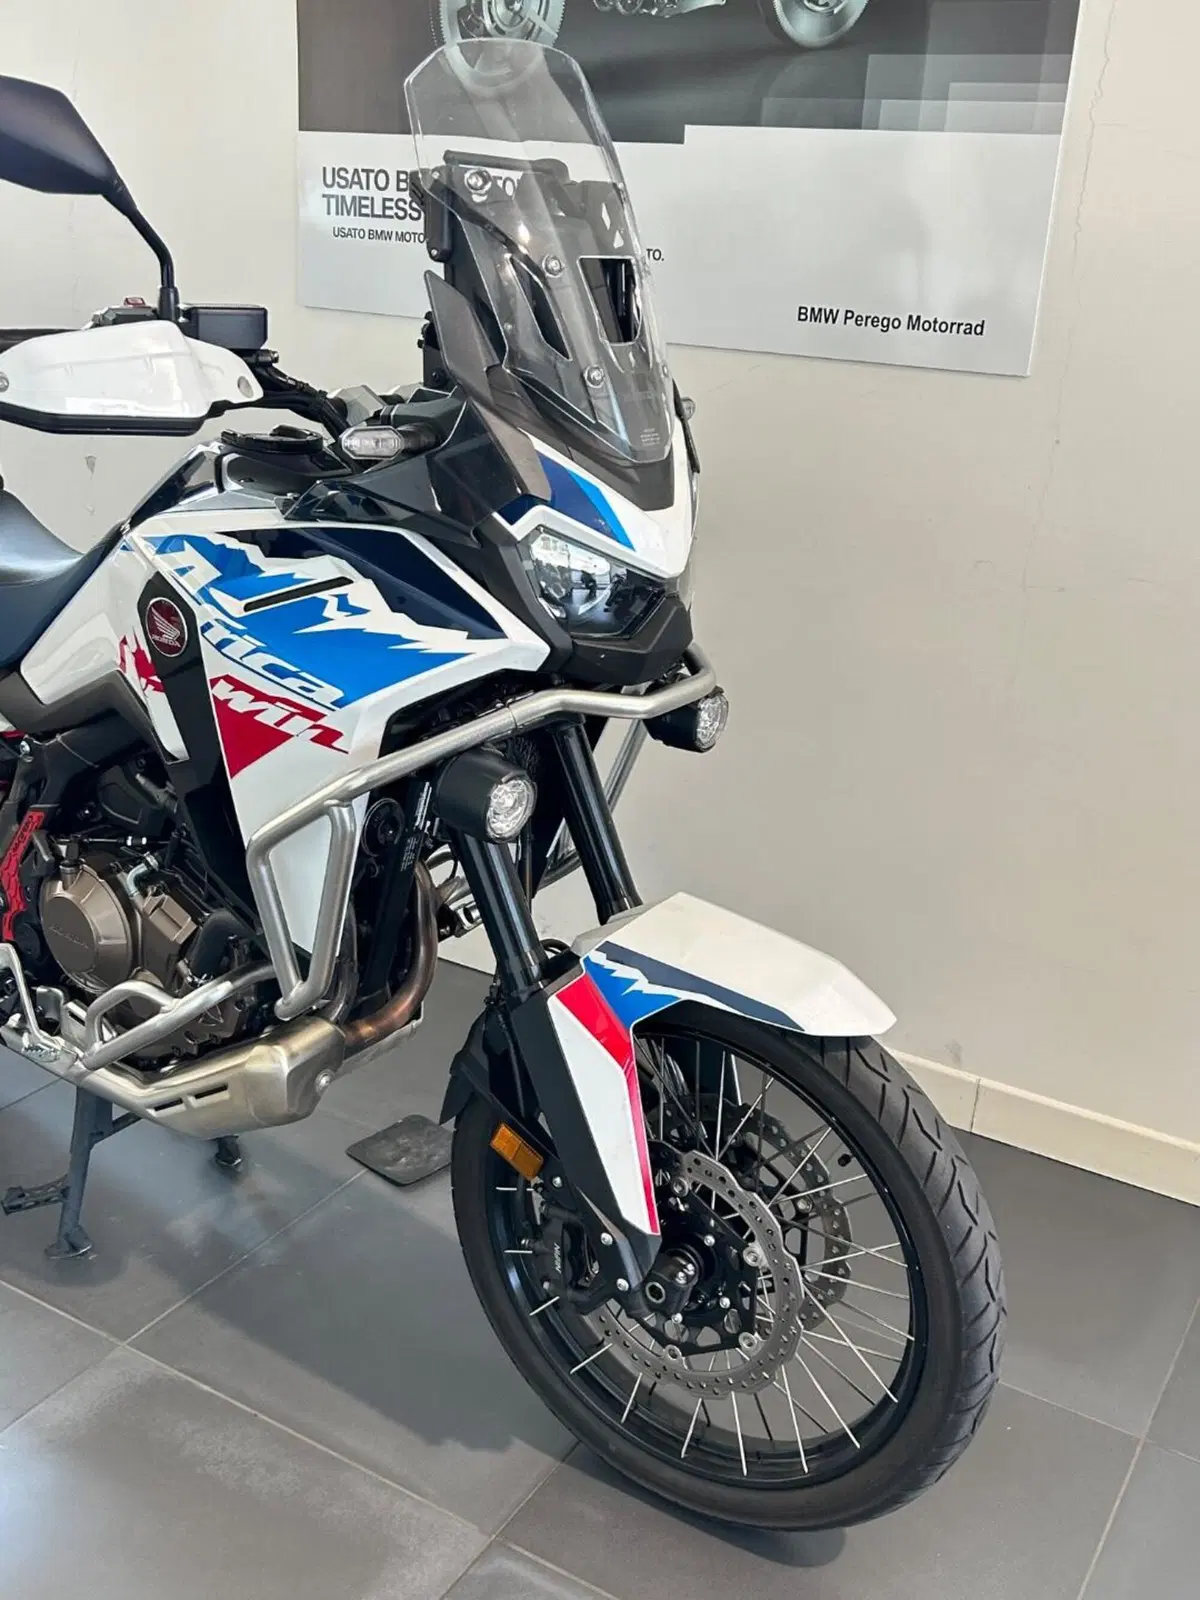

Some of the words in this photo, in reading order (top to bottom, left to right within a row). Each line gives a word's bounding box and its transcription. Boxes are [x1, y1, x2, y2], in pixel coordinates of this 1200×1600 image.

[322, 166, 389, 191] USATO
[322, 193, 422, 221] TIMELESS
[333, 226, 366, 240] USATO
[368, 229, 393, 241] BMW
[797, 306, 840, 325] BMW
[843, 309, 901, 333] Perego
[906, 314, 986, 336] Motorrad
